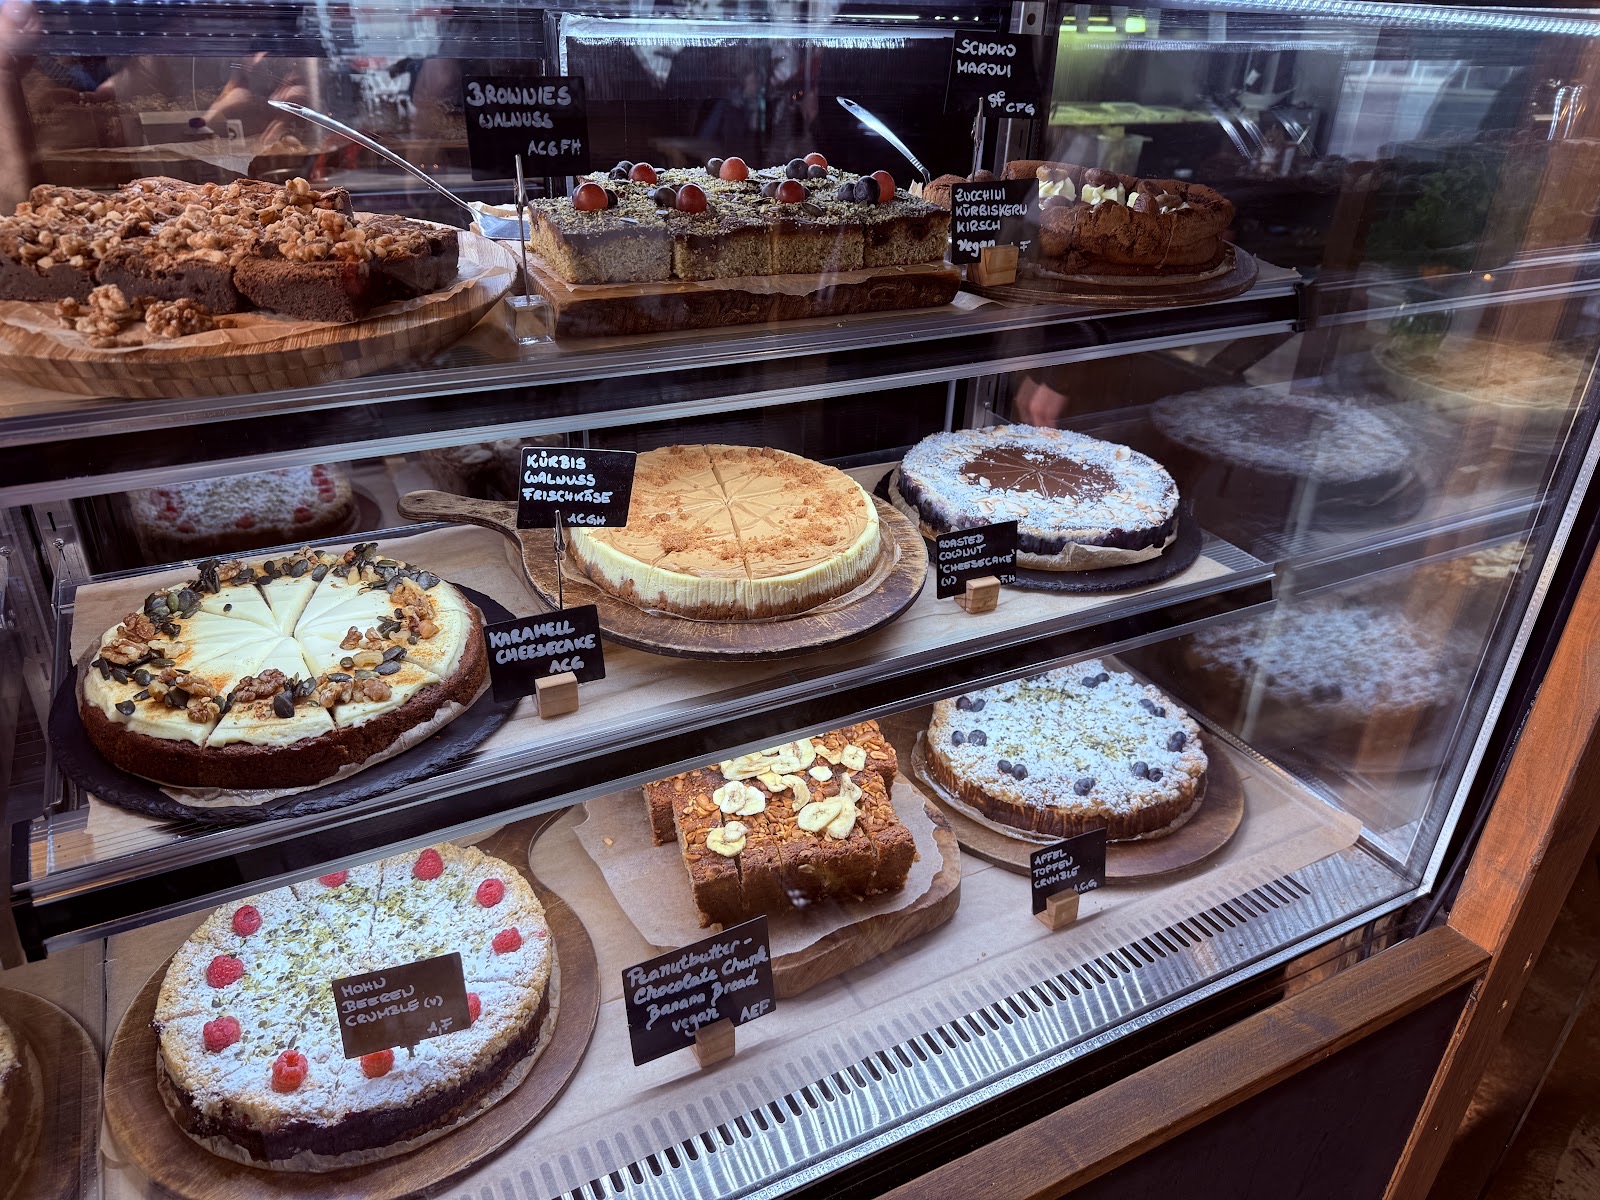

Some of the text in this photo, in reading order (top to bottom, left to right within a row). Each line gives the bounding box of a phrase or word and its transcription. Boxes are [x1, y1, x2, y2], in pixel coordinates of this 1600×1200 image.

[957, 220, 1001, 233] KIRSCH
[527, 451, 586, 469] KÜRBIS
[524, 470, 596, 486] WALNUSS
[522, 488, 613, 503] FRISCHKÄSE
[939, 534, 984, 549] ROASTED
[489, 620, 575, 648] KARAMELL
[496, 634, 596, 664] CHEESECAKE
[549, 656, 585, 674] ACG
[1033, 856, 1073, 877] TOPFEN
[1034, 865, 1080, 889] CRUMBLE
[634, 945, 769, 1005] Chocolate Chunk
[341, 977, 386, 997] MOHN
[342, 985, 415, 1013] BEEREN
[646, 969, 759, 1030] Banana Bread
[345, 999, 419, 1026] CRUMBLE
[740, 999, 770, 1022] AEF
